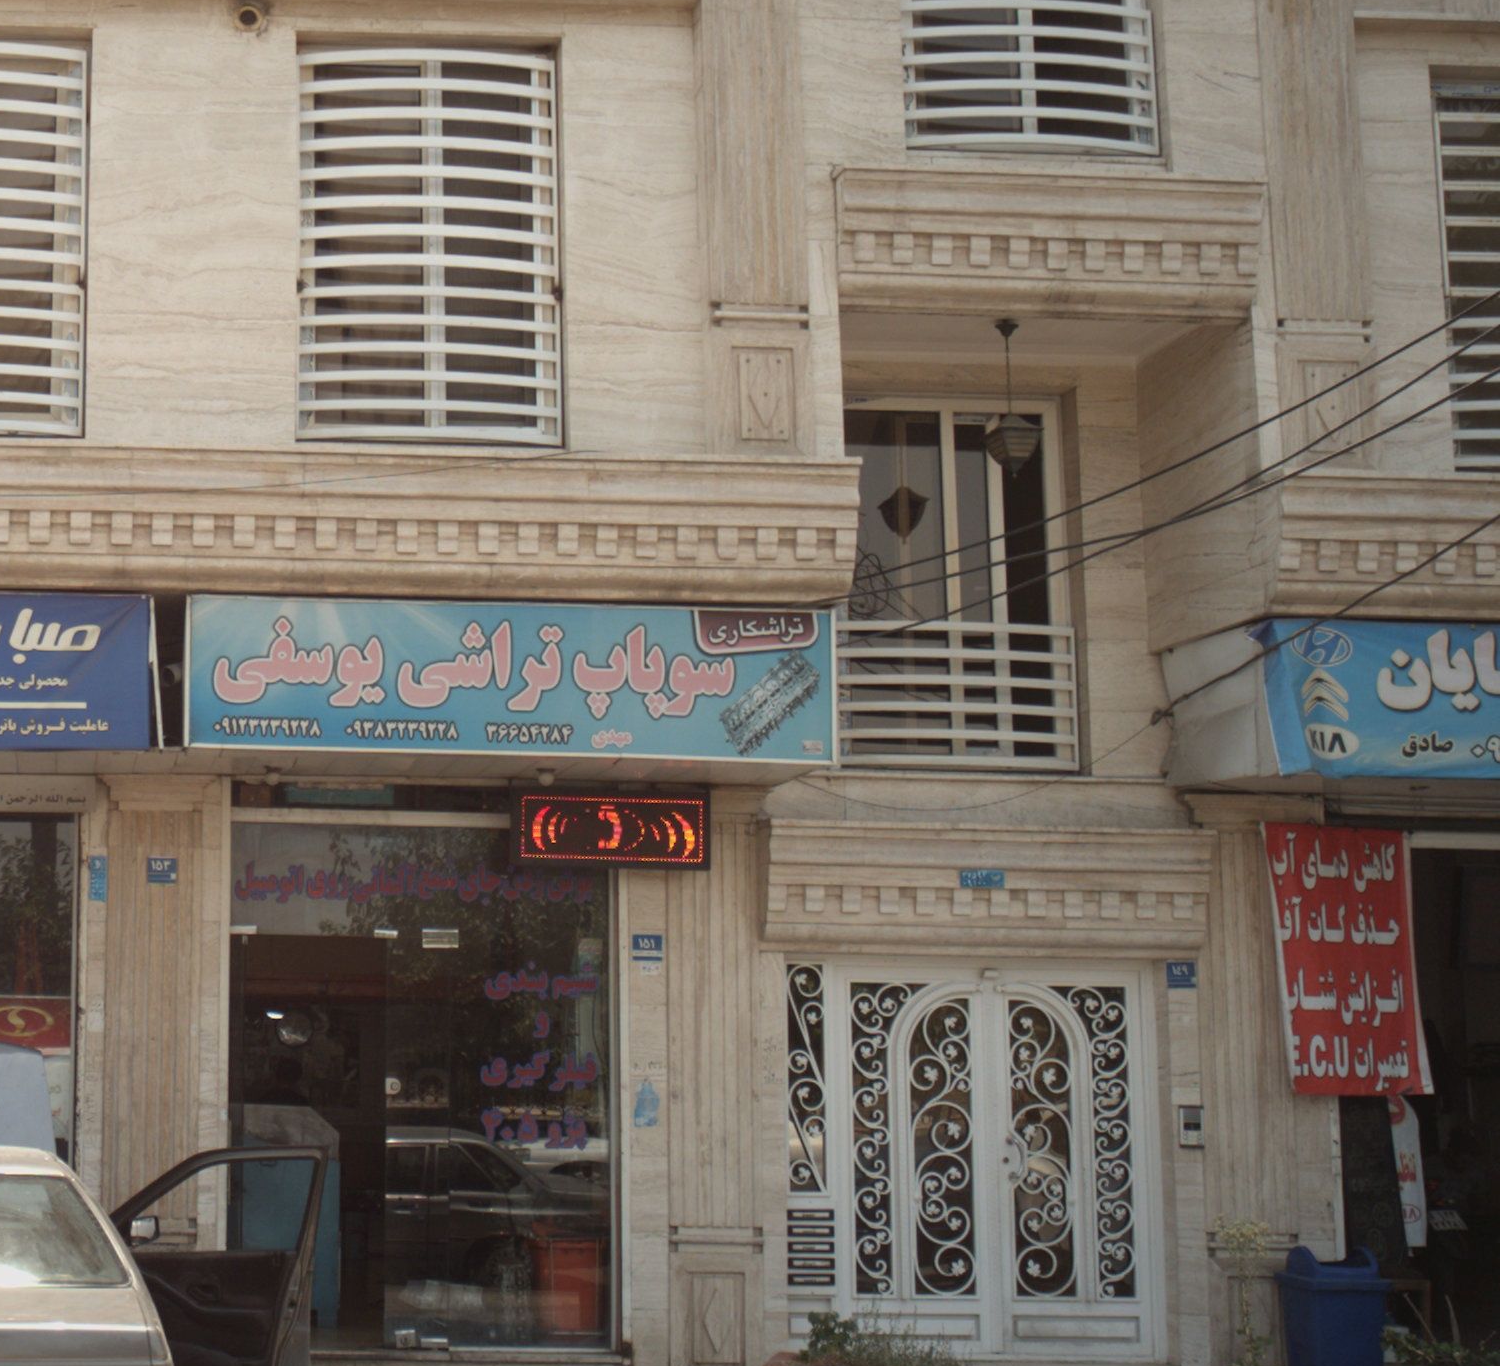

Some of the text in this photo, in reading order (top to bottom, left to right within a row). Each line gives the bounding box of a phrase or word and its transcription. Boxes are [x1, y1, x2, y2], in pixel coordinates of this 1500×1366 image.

[8, 606, 103, 666] صبا
[708, 616, 804, 645] تراشکاری
[19, 672, 69, 691] محصولی
[213, 615, 736, 720] سوپاپ تراشی یوسفی
[1376, 627, 1500, 712] ایان
[1401, 731, 1454, 758] صادق
[1271, 831, 1396, 894] کاهش دمای آب
[1350, 903, 1401, 946] حذف
[1341, 968, 1405, 1028] افزایش
[1354, 1037, 1410, 1092] تعمیرات
